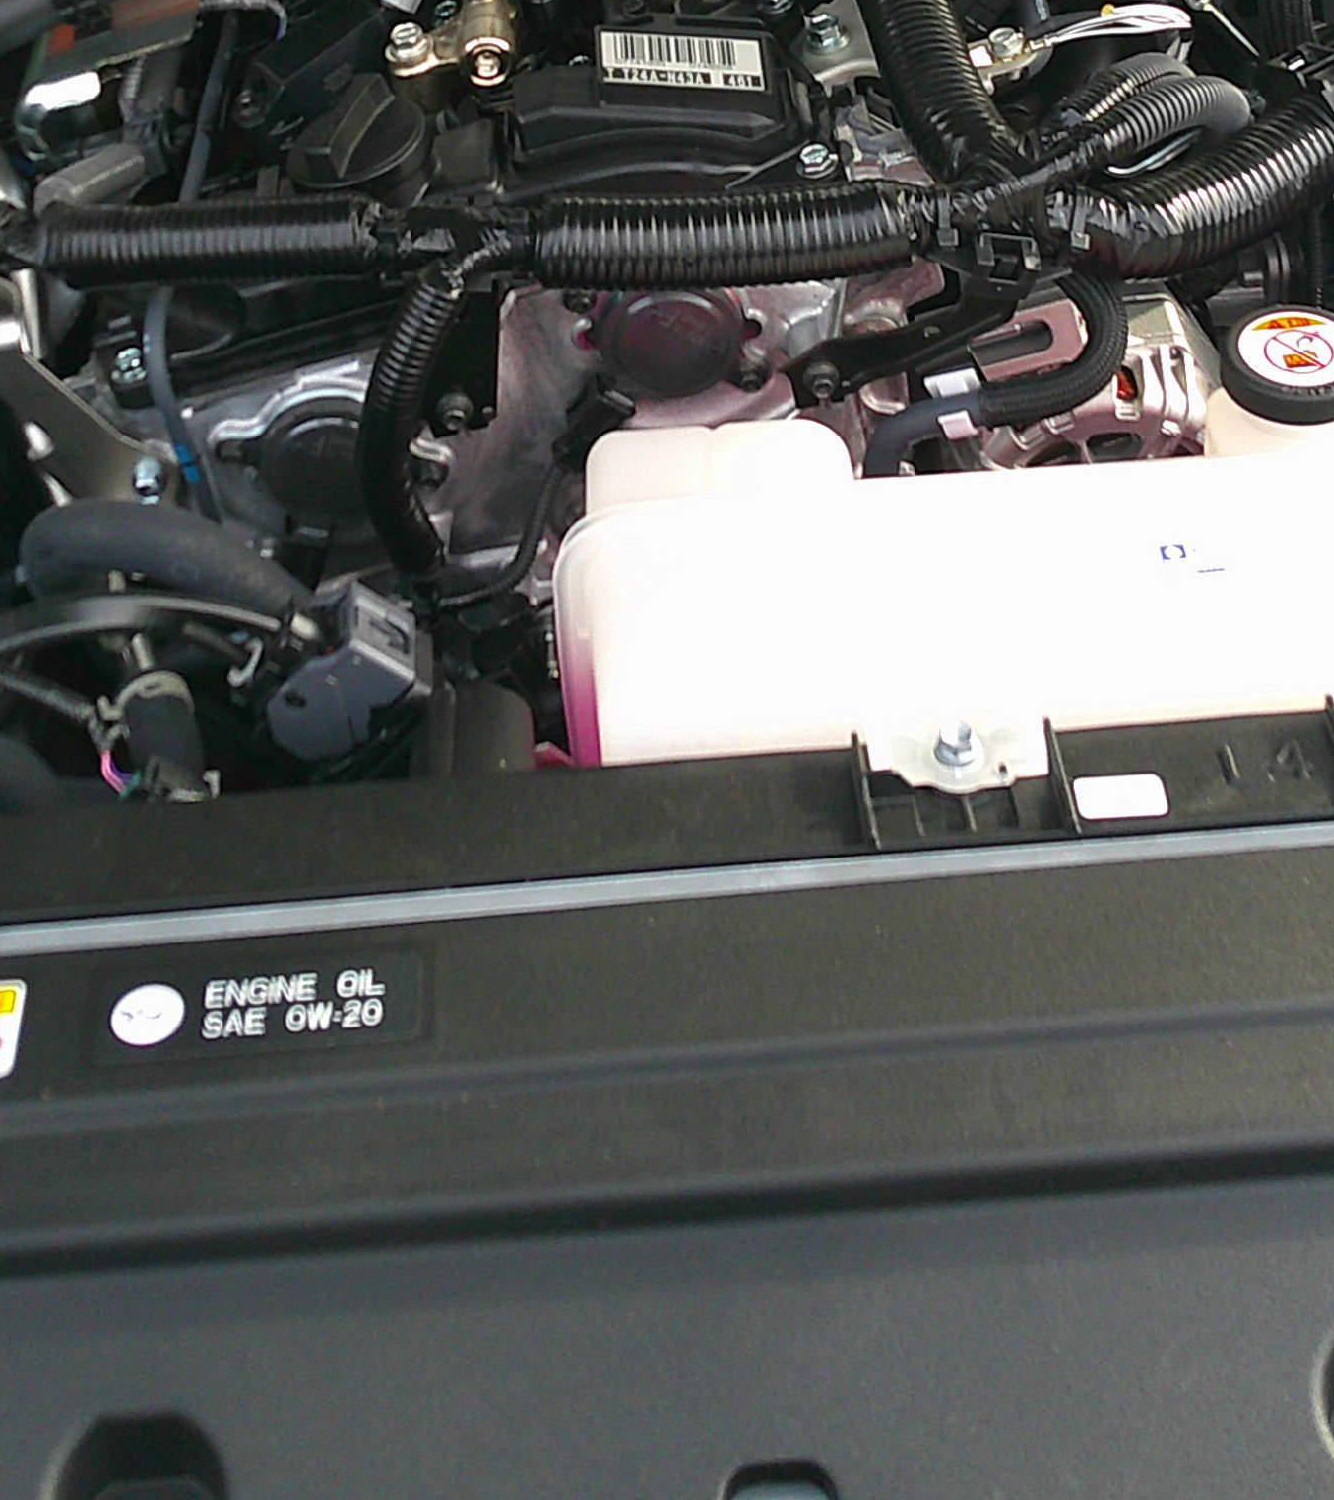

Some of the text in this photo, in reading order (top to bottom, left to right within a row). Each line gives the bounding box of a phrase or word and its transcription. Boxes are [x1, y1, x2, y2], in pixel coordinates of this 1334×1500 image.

[204, 968, 387, 1010] ENGINE OIL
[201, 997, 384, 1040] SAE 0W-20
